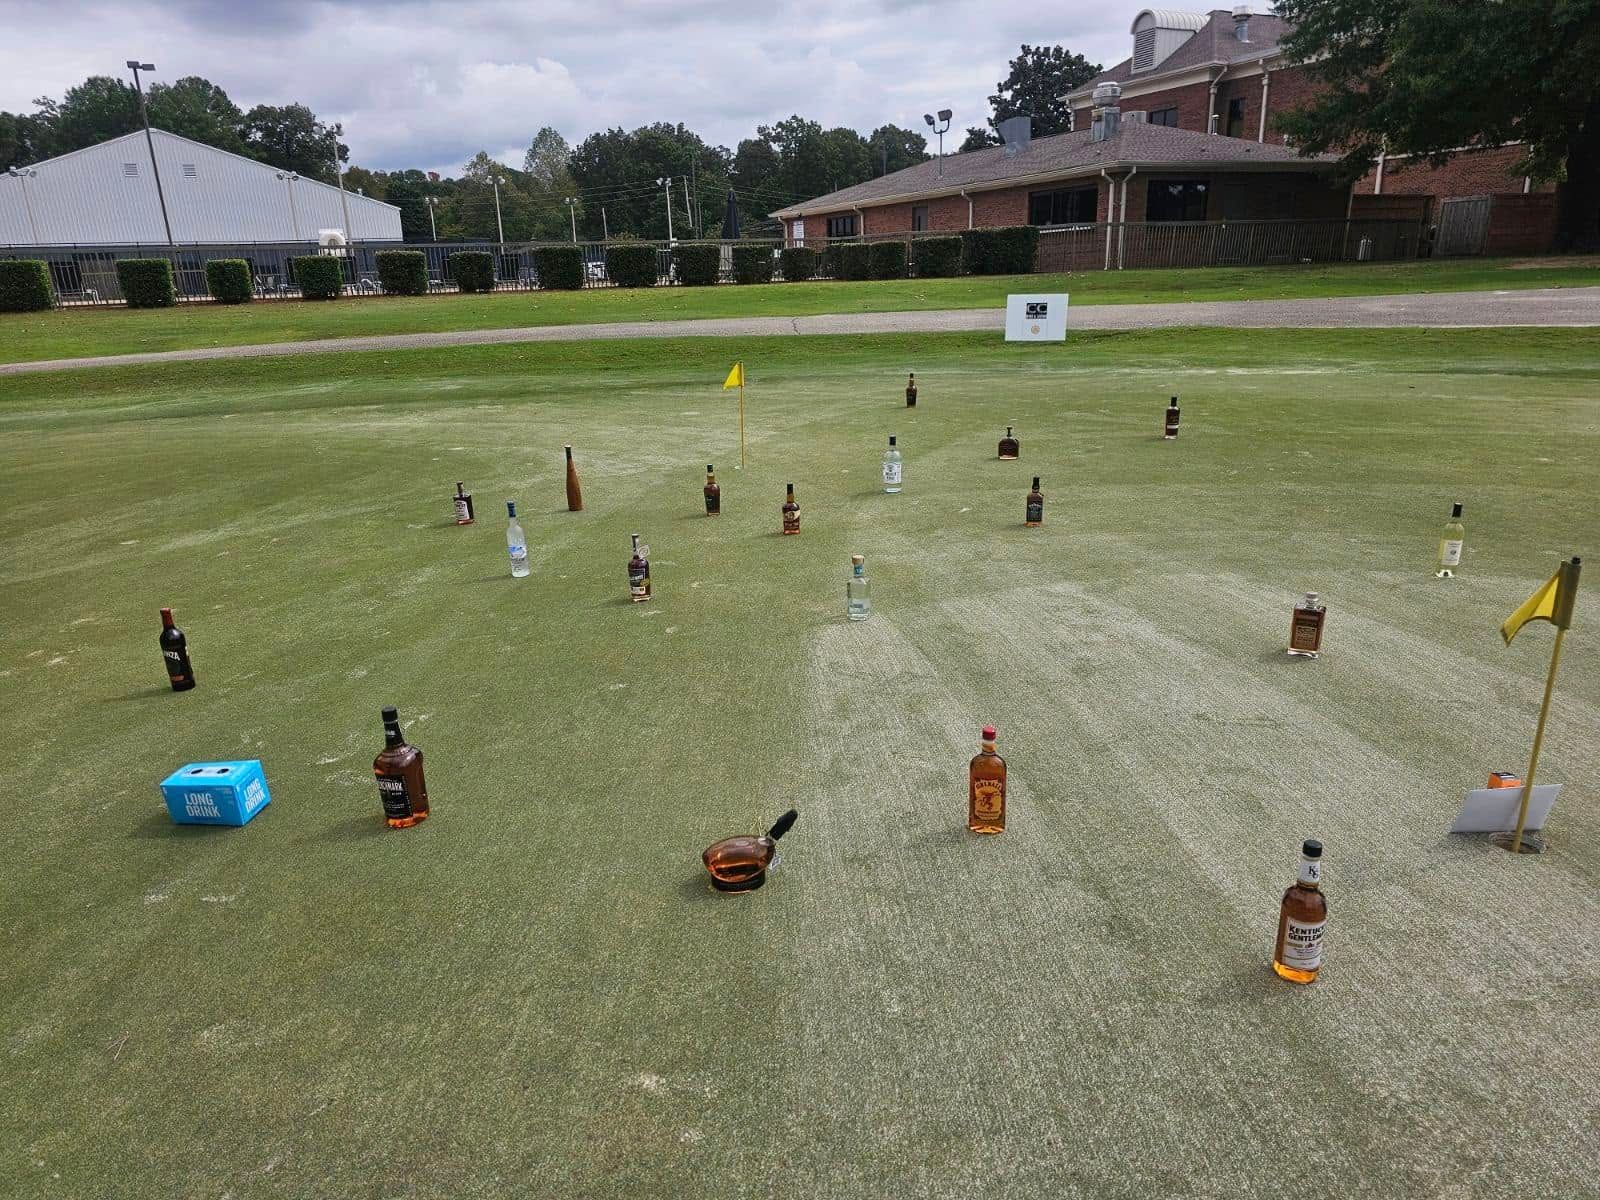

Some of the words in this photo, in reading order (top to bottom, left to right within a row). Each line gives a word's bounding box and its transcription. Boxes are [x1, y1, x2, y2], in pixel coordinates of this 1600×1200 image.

[1027, 303, 1047, 313] CC
[243, 778, 261, 800] LONG
[184, 792, 214, 805] LONG
[245, 788, 266, 814] DRINK
[186, 805, 221, 818] DRINK
[1289, 923, 1325, 935] KENTUCK
